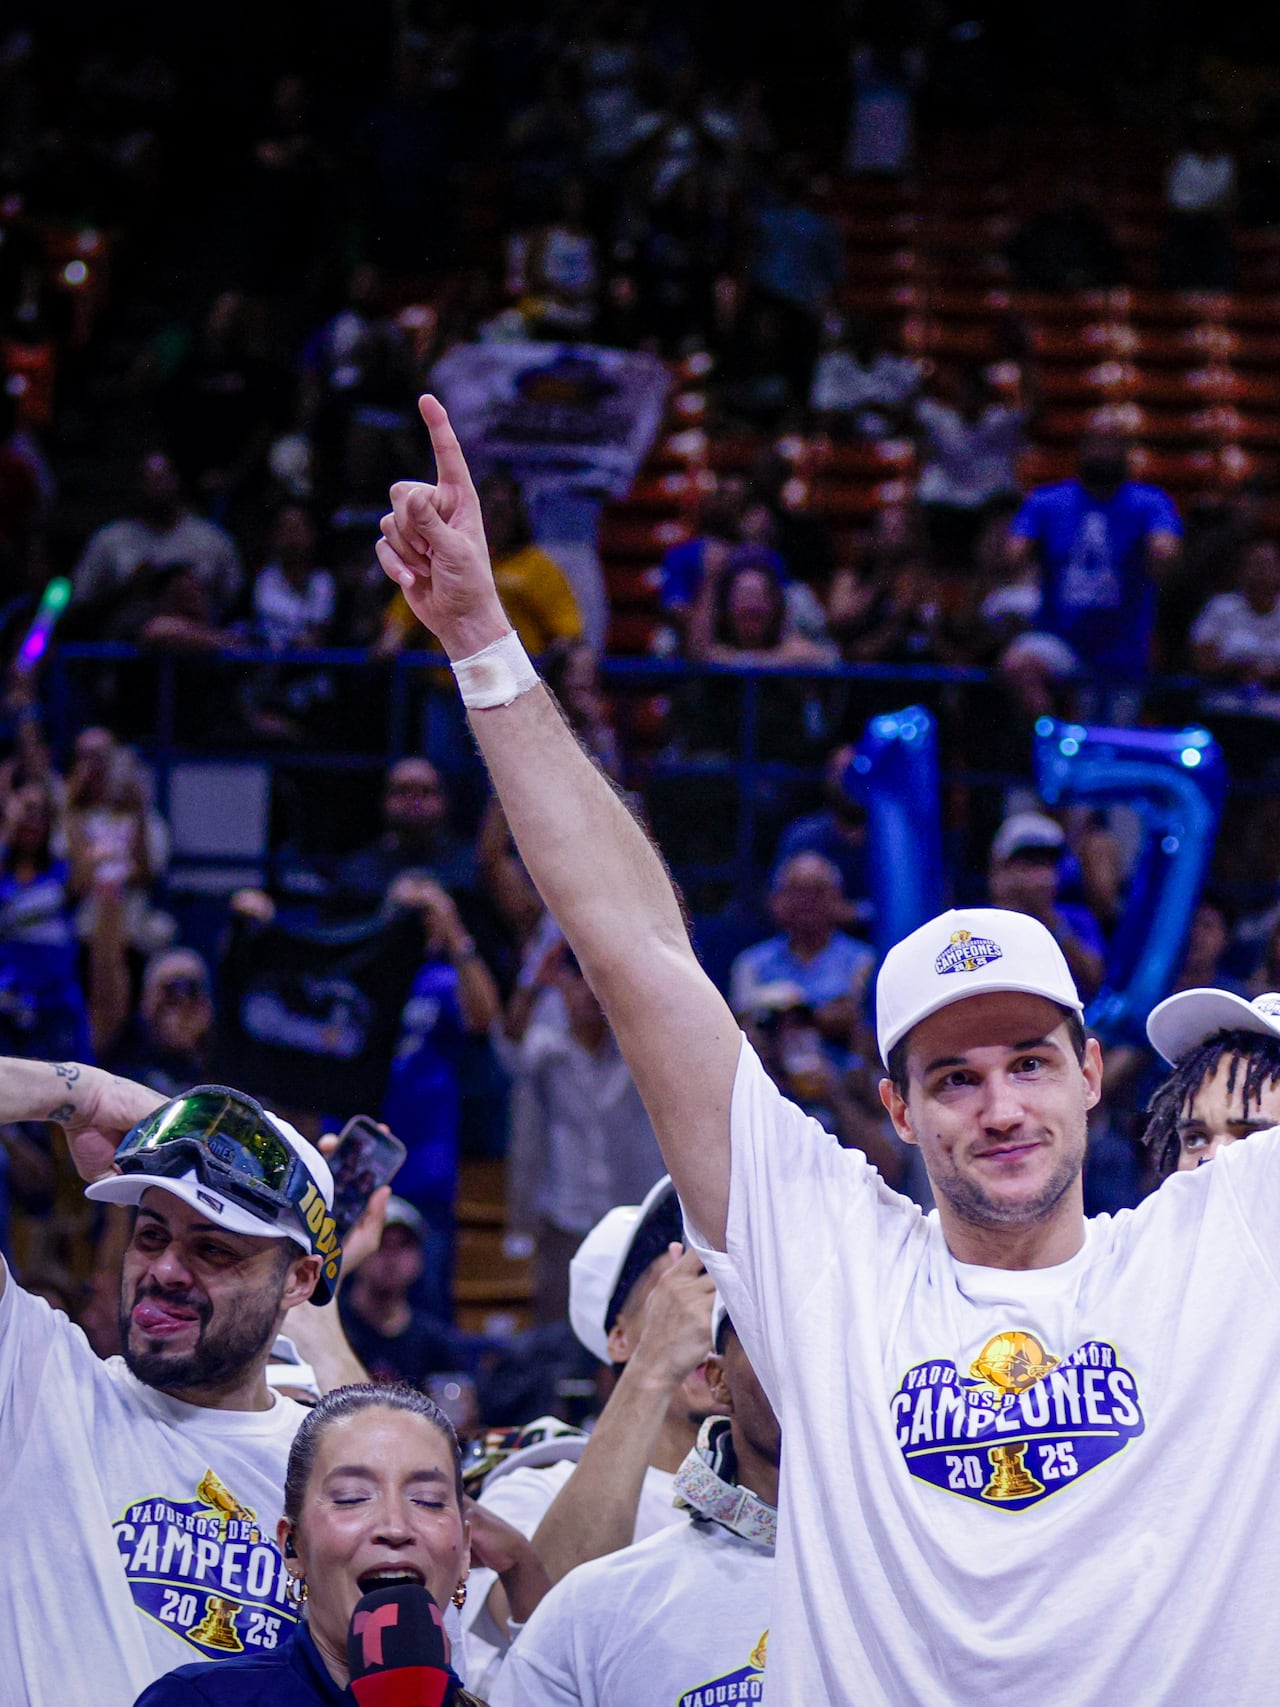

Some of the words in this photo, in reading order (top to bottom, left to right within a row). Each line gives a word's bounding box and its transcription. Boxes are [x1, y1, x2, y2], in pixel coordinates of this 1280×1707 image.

[935, 944, 1002, 974] CAMPEONES
[946, 1455, 983, 1489] 20
[1038, 1441, 1079, 1480] 25
[228, 1520, 251, 1540] DE
[159, 1588, 198, 1627] 20
[245, 1613, 282, 1650] 25
[683, 1681, 761, 1707] VAQUERO
